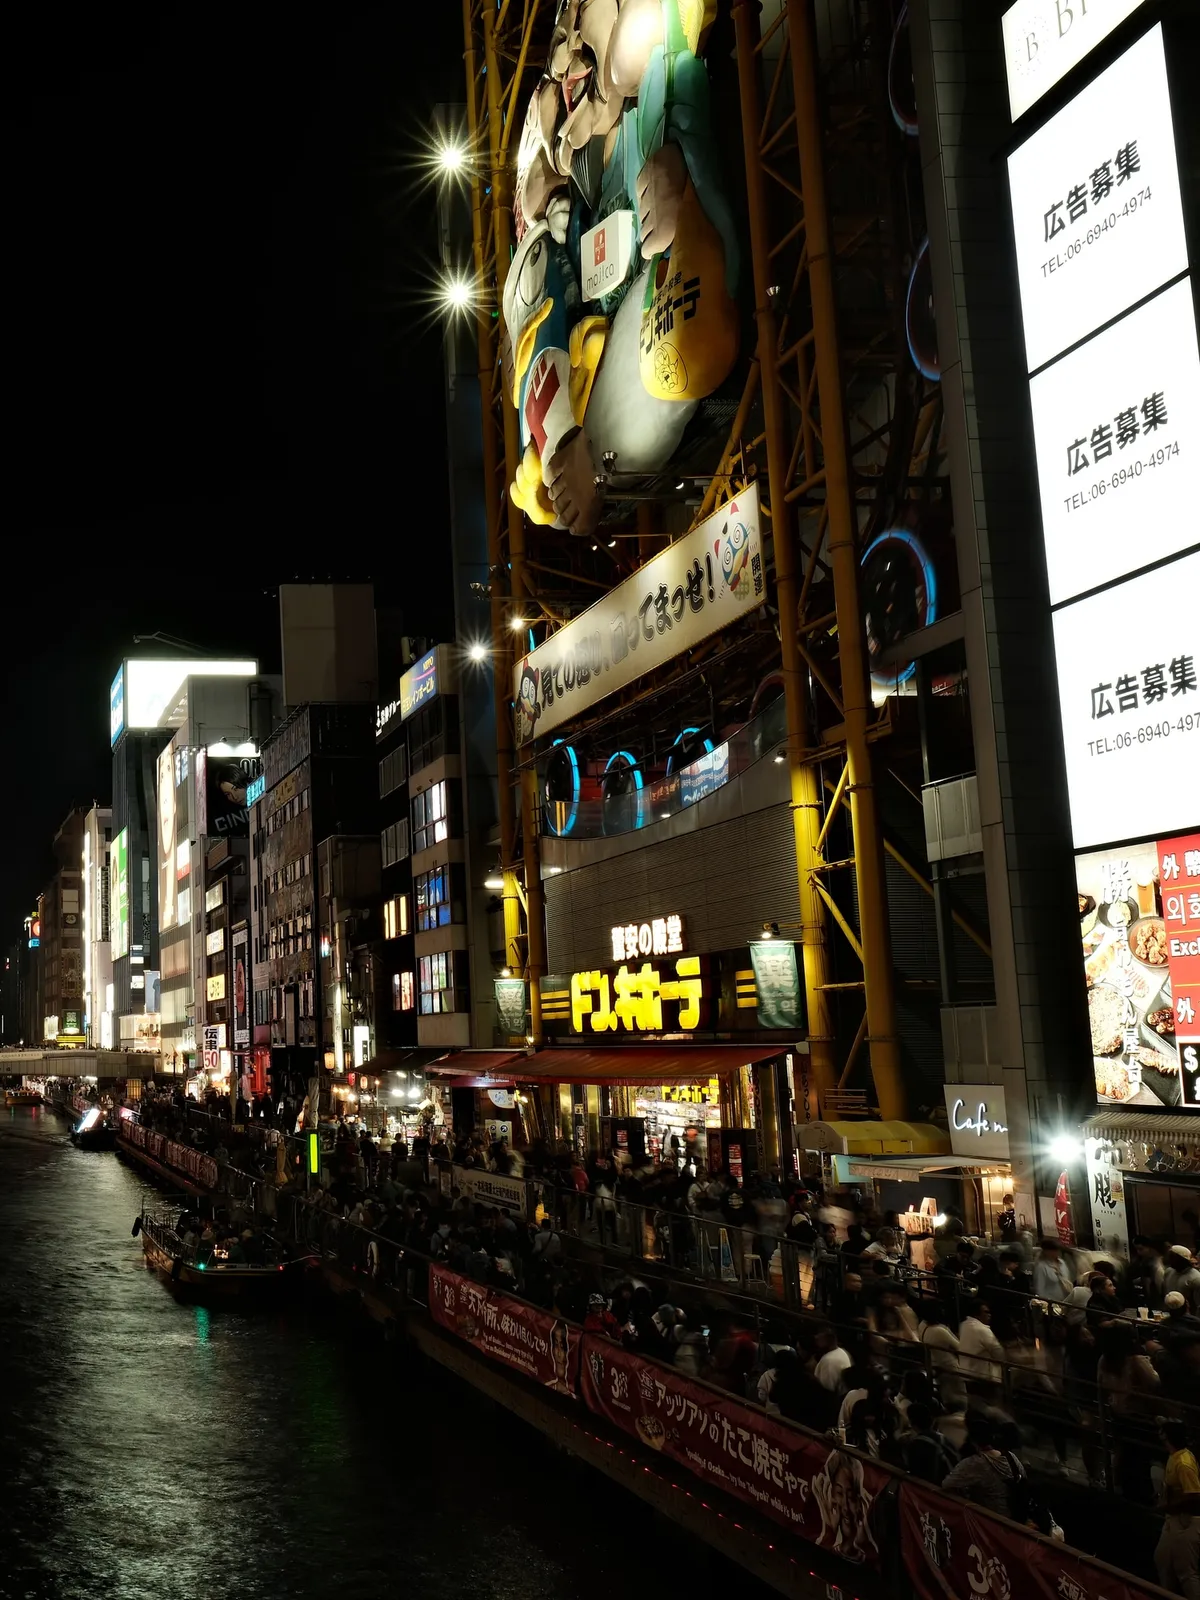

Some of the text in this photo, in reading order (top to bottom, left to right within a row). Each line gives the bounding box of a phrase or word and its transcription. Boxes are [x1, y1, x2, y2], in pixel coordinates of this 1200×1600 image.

[1042, 139, 1141, 243] 広告募集
[1041, 186, 1152, 278] TEL:06-6940-4974
[1066, 391, 1169, 477] 広告募集
[1064, 441, 1180, 513] TEL:06-6940-4974
[1090, 654, 1197, 720] 広告募集
[204, 1051, 218, 1068] 50
[952, 1098, 991, 1137] Cafe
